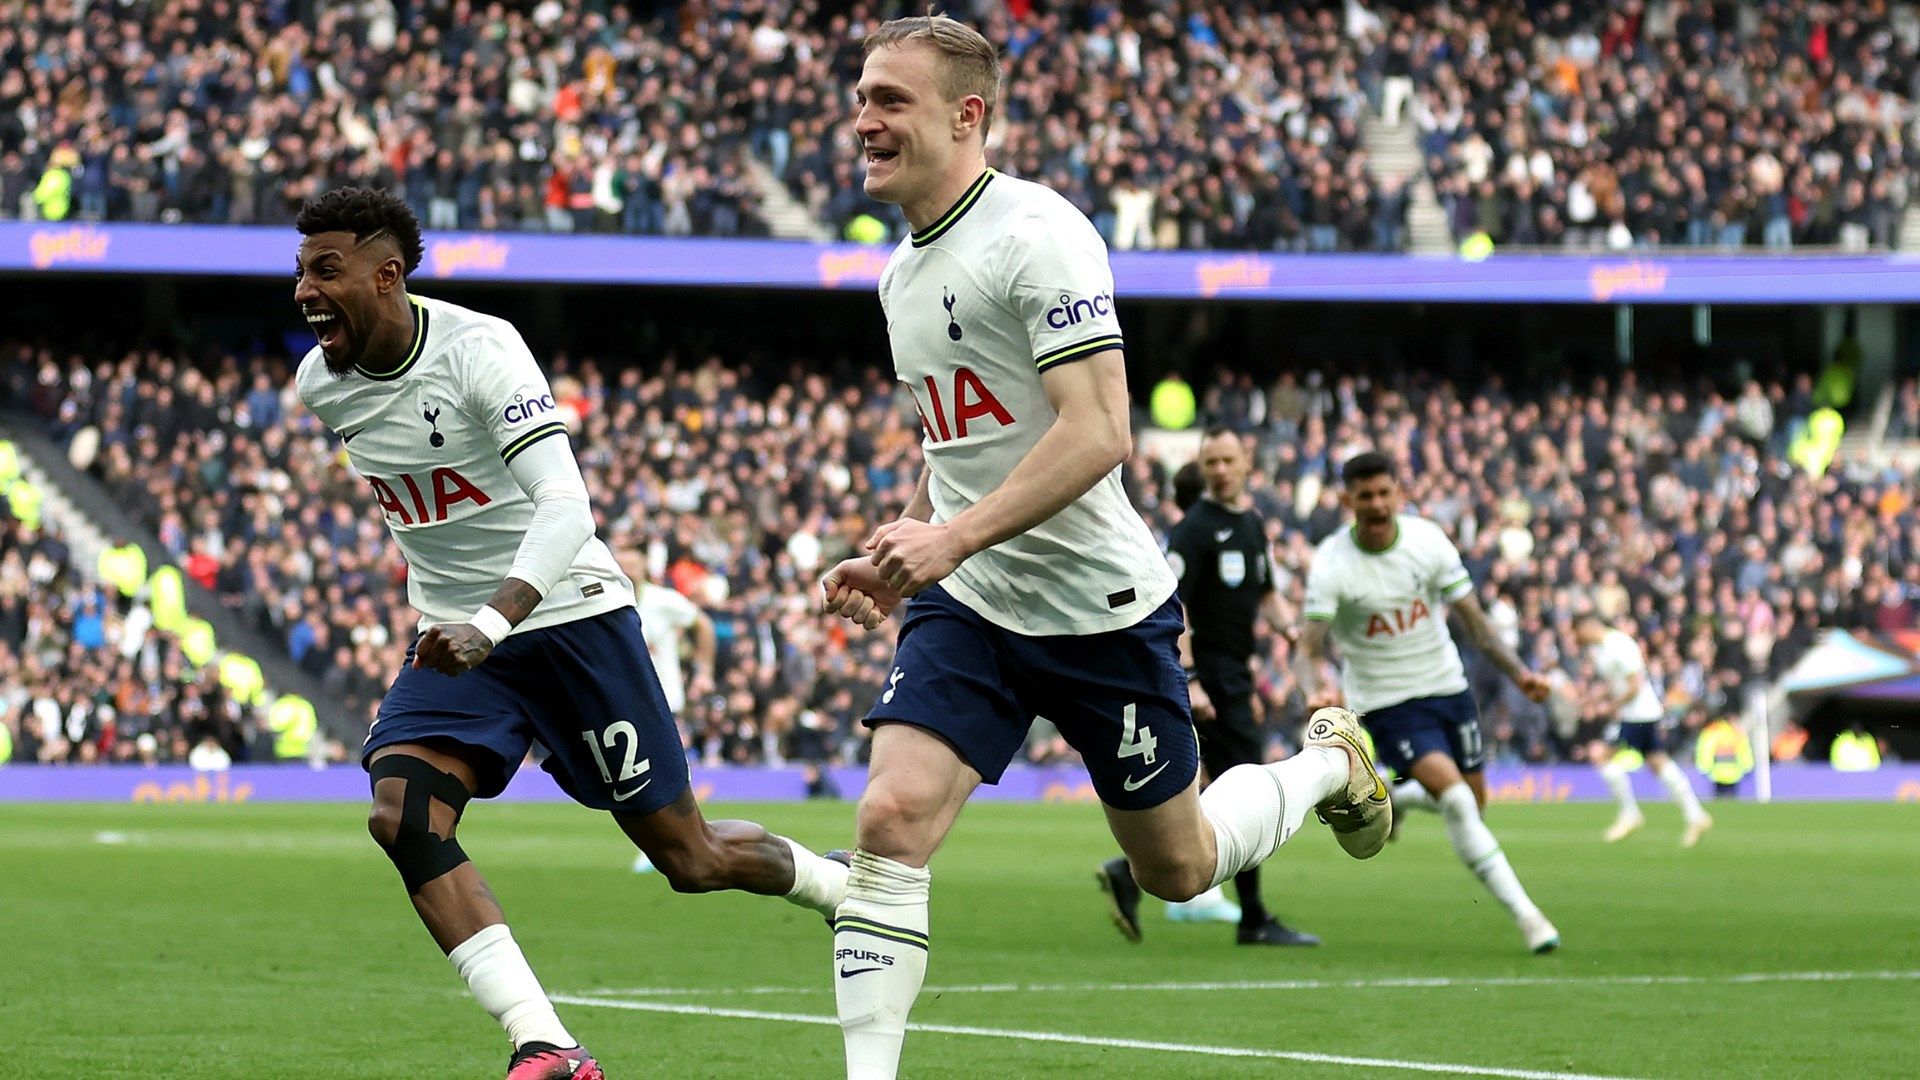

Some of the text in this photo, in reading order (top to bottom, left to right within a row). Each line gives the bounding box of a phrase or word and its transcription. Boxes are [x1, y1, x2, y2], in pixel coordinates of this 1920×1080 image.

[369, 467, 492, 525] AIA
[1366, 598, 1430, 638] AIA
[582, 720, 650, 783] 12
[1117, 702, 1158, 765] 4
[836, 948, 895, 966] SPURS
